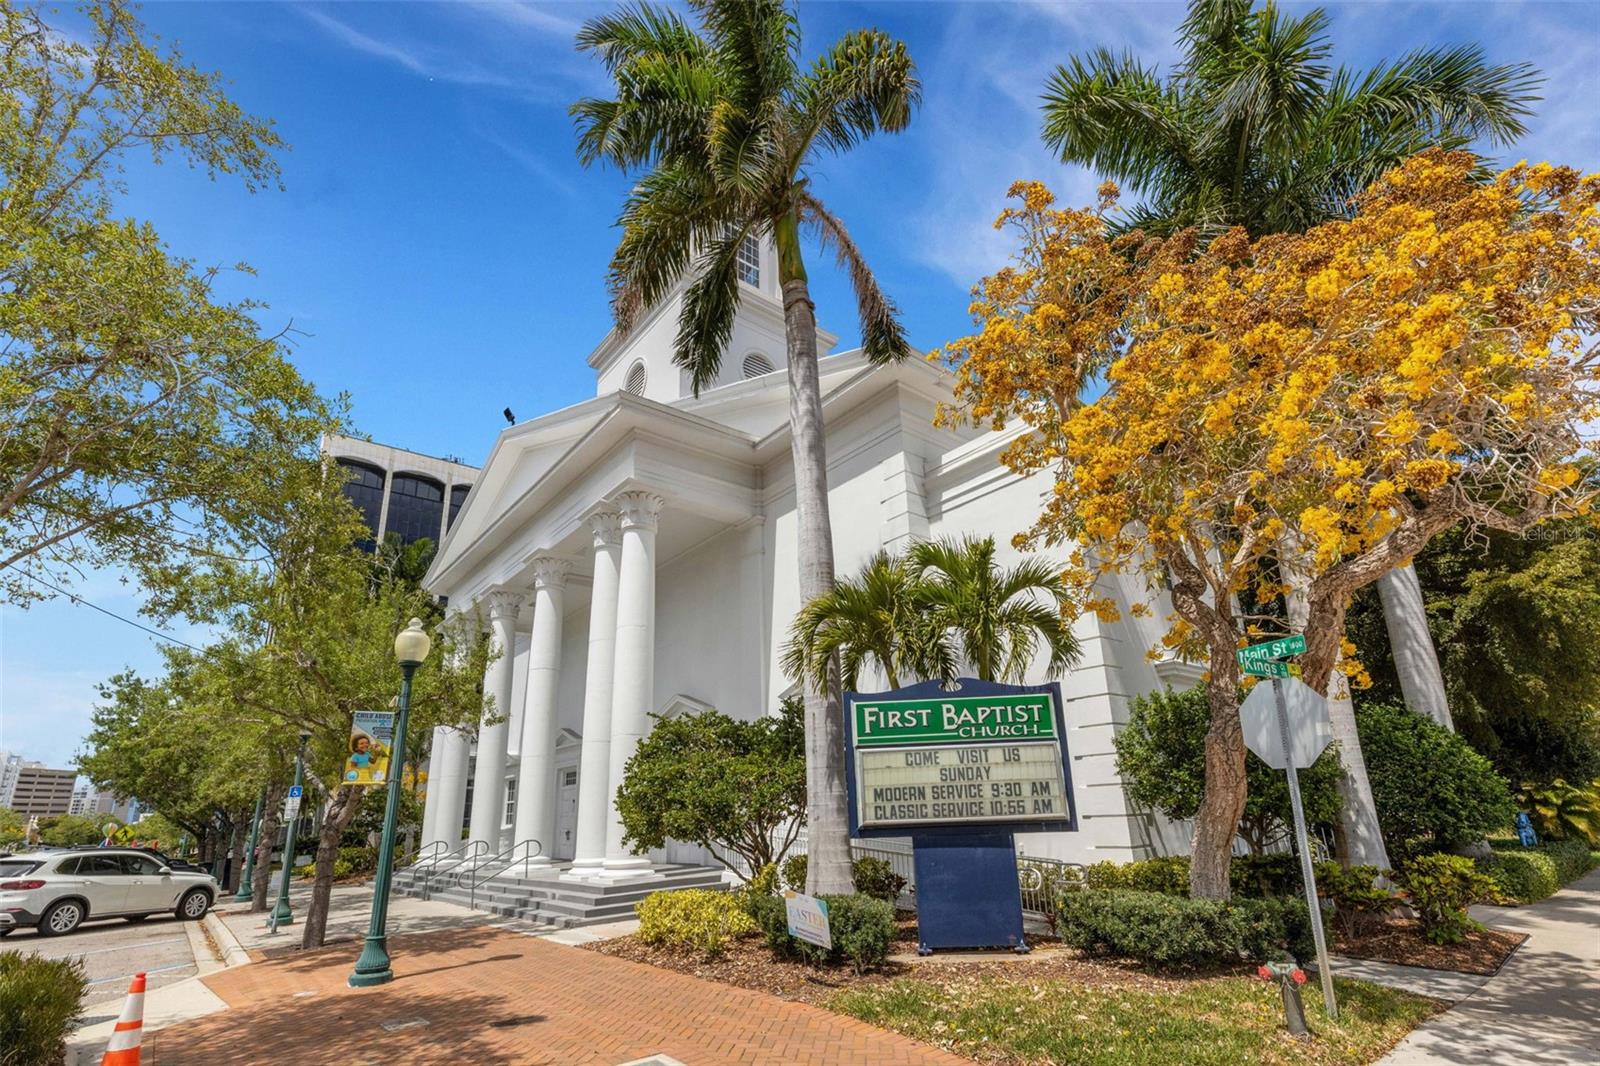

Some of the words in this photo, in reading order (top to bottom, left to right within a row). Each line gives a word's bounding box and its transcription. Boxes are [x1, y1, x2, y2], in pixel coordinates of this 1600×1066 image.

[1239, 647, 1269, 663] Main
[1272, 642, 1287, 656] St
[1244, 657, 1278, 675] Kings
[863, 706, 931, 734] FIRST
[941, 703, 1043, 730] BAPTIST
[959, 724, 1038, 738] CHURCH
[905, 751, 940, 766] COME
[957, 749, 989, 764] VISIT
[1003, 748, 1021, 762] US
[939, 766, 991, 782] SUNDAY
[874, 785, 926, 802] MODERN
[931, 783, 983, 800] SERVICE
[991, 782, 1022, 797] 9:30
[1031, 781, 1051, 796] AM
[874, 803, 928, 820] CLASSIC
[932, 801, 984, 818] SERVICE
[990, 800, 1025, 816] 10:55
[1033, 799, 1053, 814] AM
